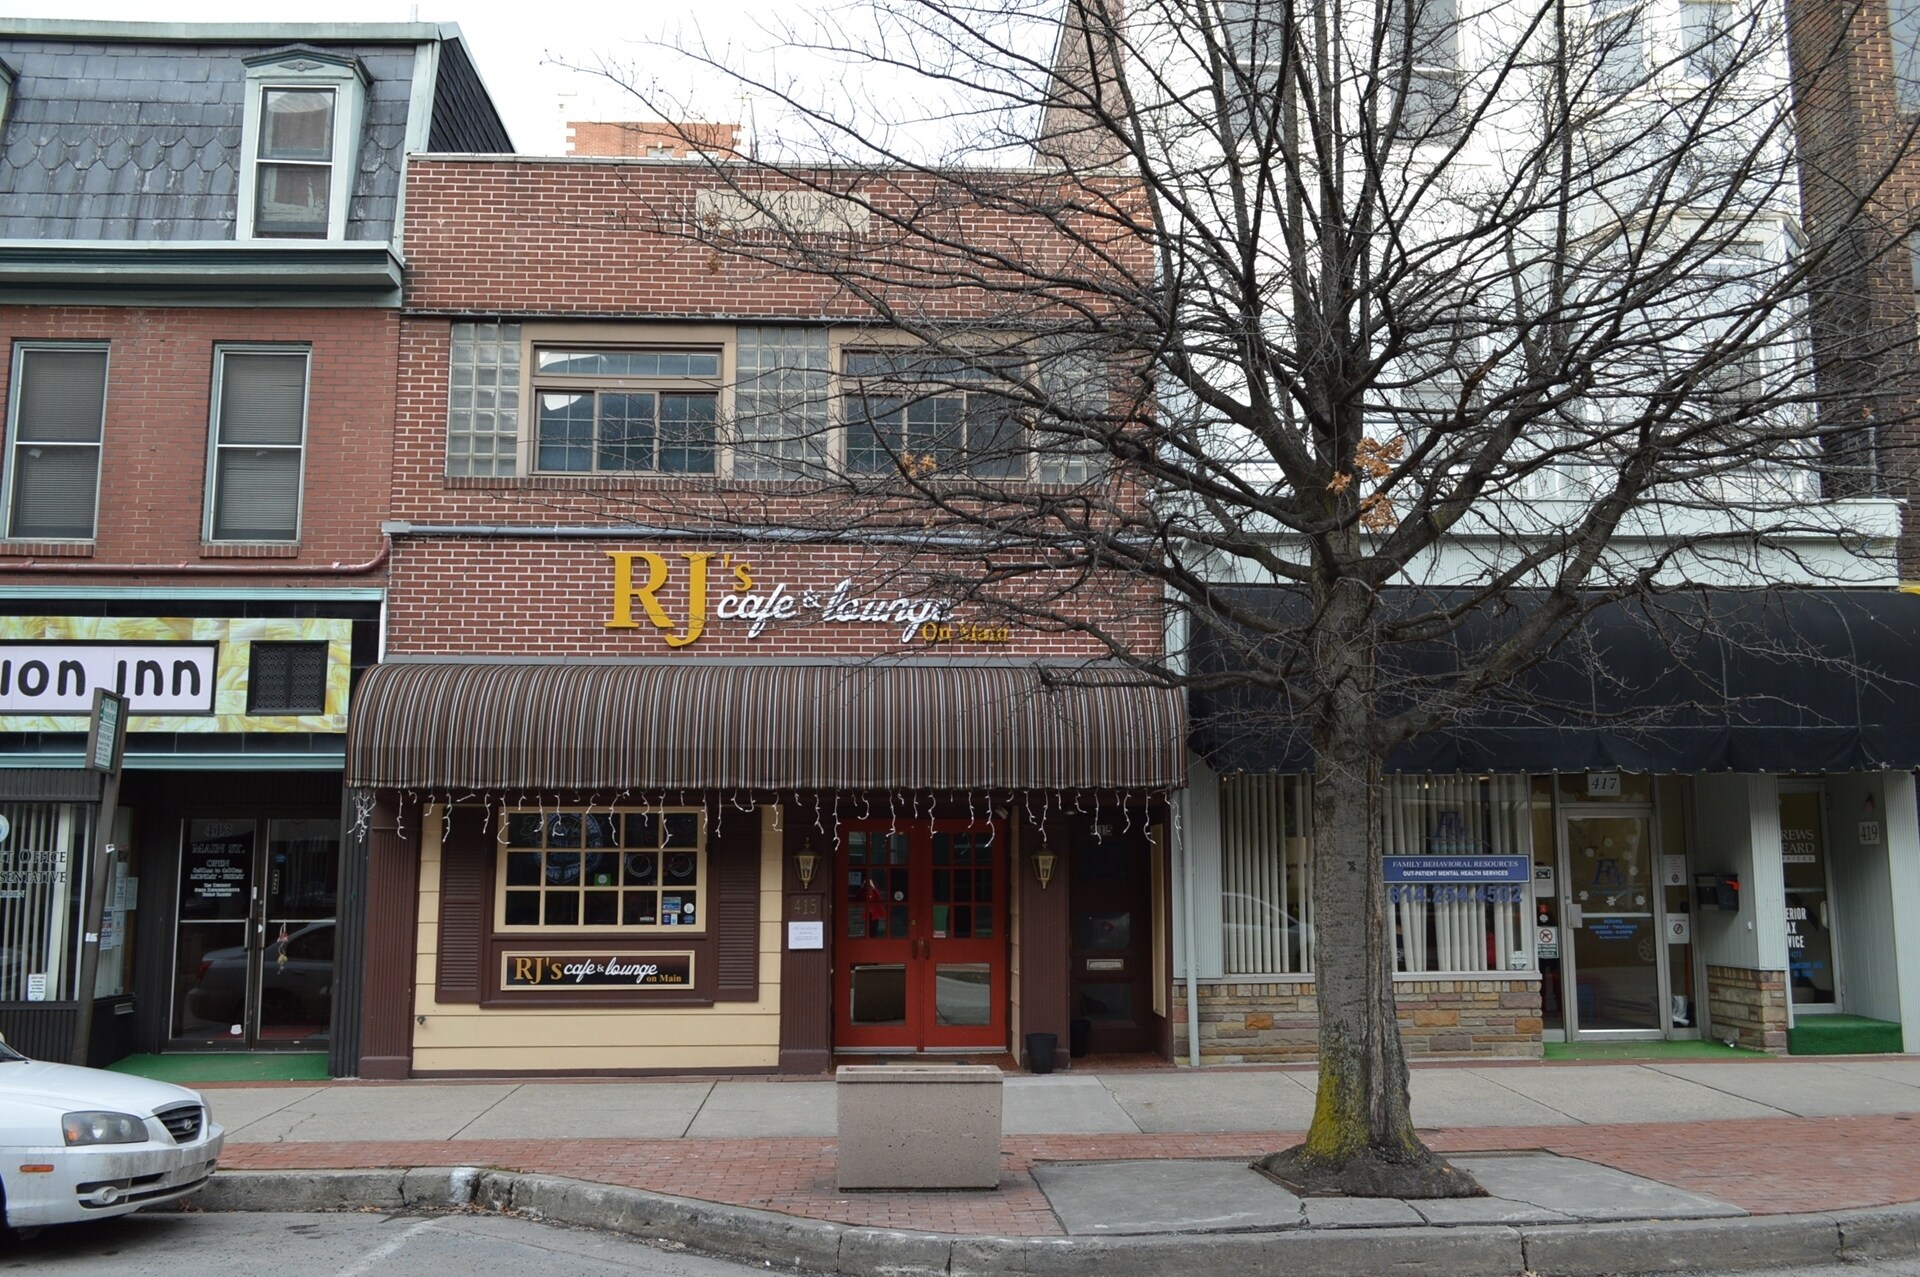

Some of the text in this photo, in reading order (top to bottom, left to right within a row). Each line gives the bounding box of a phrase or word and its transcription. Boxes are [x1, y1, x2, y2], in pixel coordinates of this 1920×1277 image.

[603, 551, 954, 647] RJ's cafe & lounge
[921, 621, 951, 642] On
[1591, 776, 1617, 790] 417
[1860, 824, 1878, 841] 419
[19, 848, 67, 863] OFFICE
[1392, 860, 1519, 868] FAMILY BEHAVIORAL RESOURCES
[1402, 869, 1509, 877] OUT-PATIENT MENTAL HEALTH SERVICES
[1389, 885, 1523, 904] 814.254.4502
[793, 898, 818, 915] 415
[513, 956, 658, 985] RJ's cafe & lounge
[659, 974, 682, 983] Main
